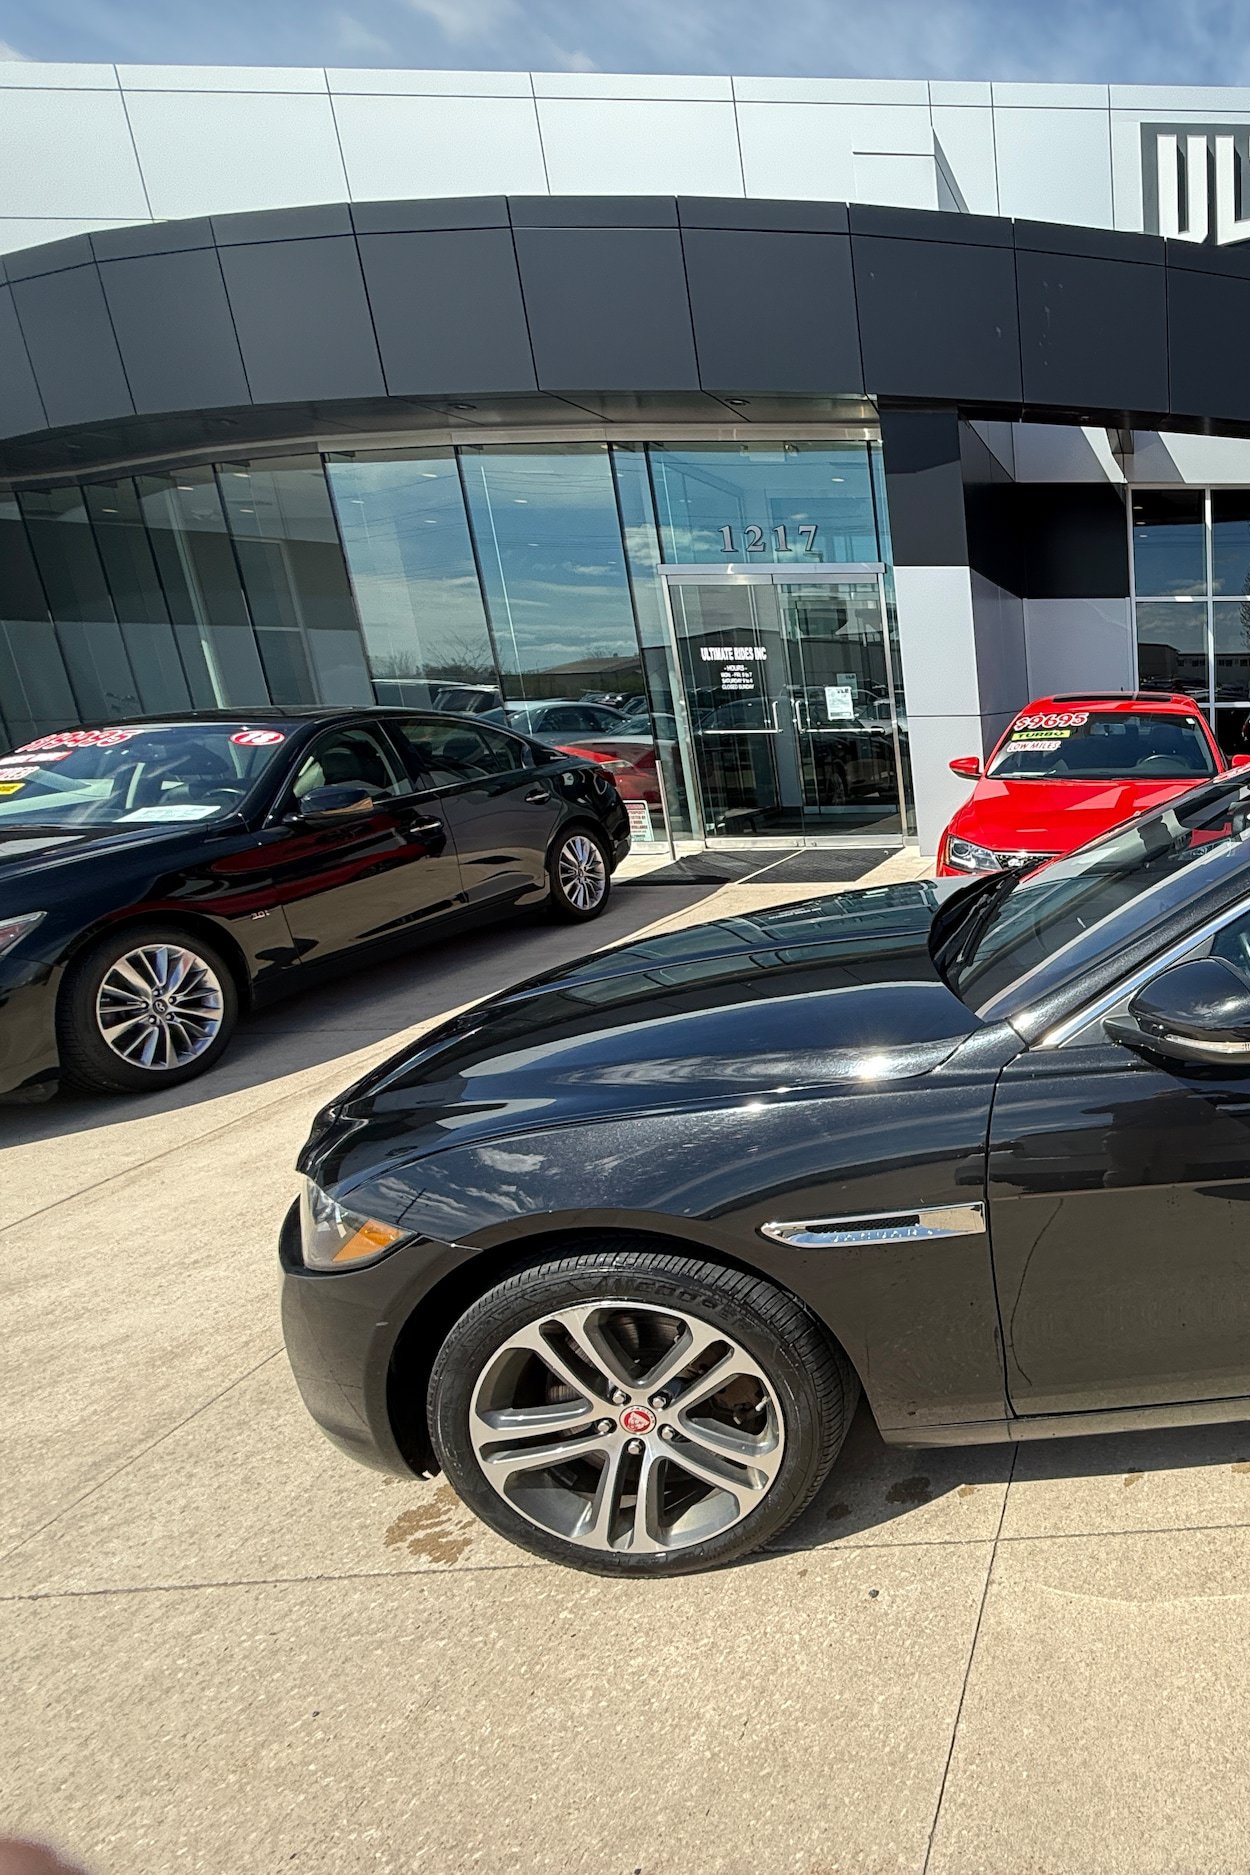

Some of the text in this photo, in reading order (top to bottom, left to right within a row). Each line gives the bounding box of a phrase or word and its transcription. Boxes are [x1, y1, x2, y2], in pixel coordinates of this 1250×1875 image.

[718, 524, 818, 552] 1217
[700, 647, 767, 661] ULTIMATE RIDES INC
[1014, 712, 1090, 731] $9695
[1008, 741, 1058, 751] LOW MILES
